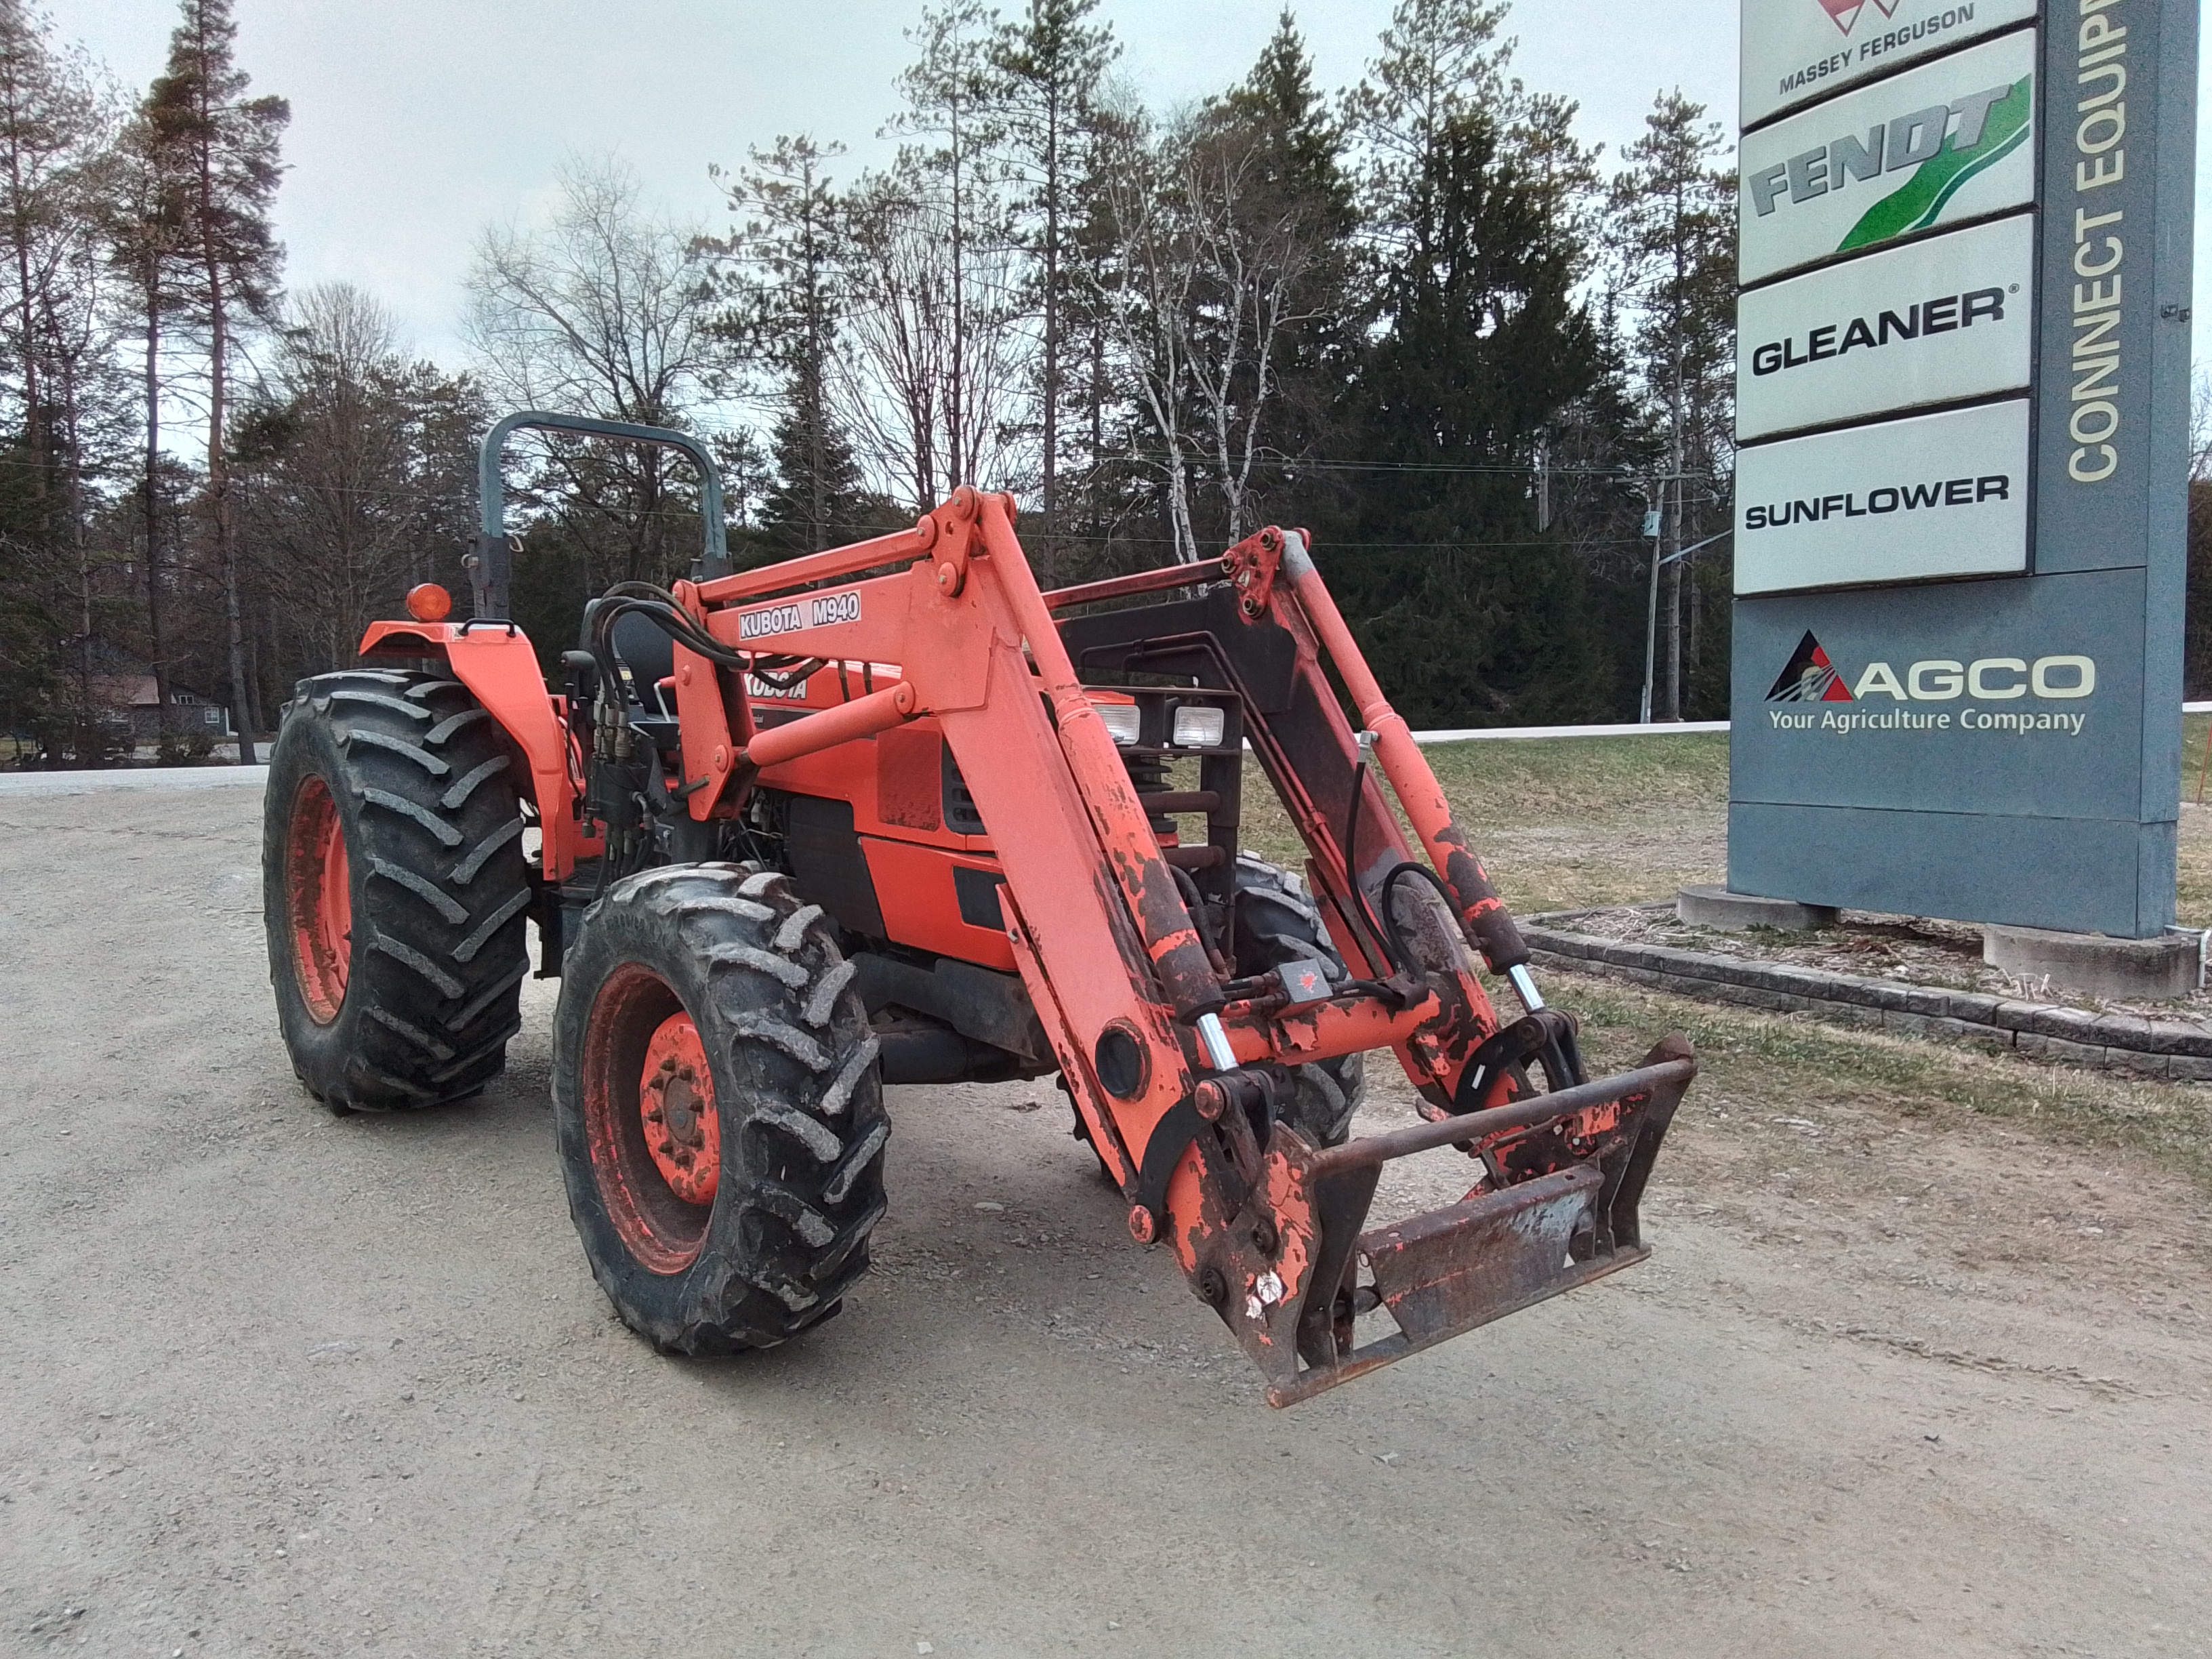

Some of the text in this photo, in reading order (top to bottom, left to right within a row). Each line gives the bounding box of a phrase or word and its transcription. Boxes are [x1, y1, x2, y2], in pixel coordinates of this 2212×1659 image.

[1779, 3, 1975, 95] MASSEY FERGUSON
[1747, 83, 2014, 218] FENDT
[2068, 208, 2124, 483] CONNECT
[1745, 474, 2009, 530] SUNFLOWER
[740, 592, 860, 639] KUBOTA M940
[1853, 655, 2095, 701] AGCO
[1769, 708, 2087, 736] Your Agriculture Company
